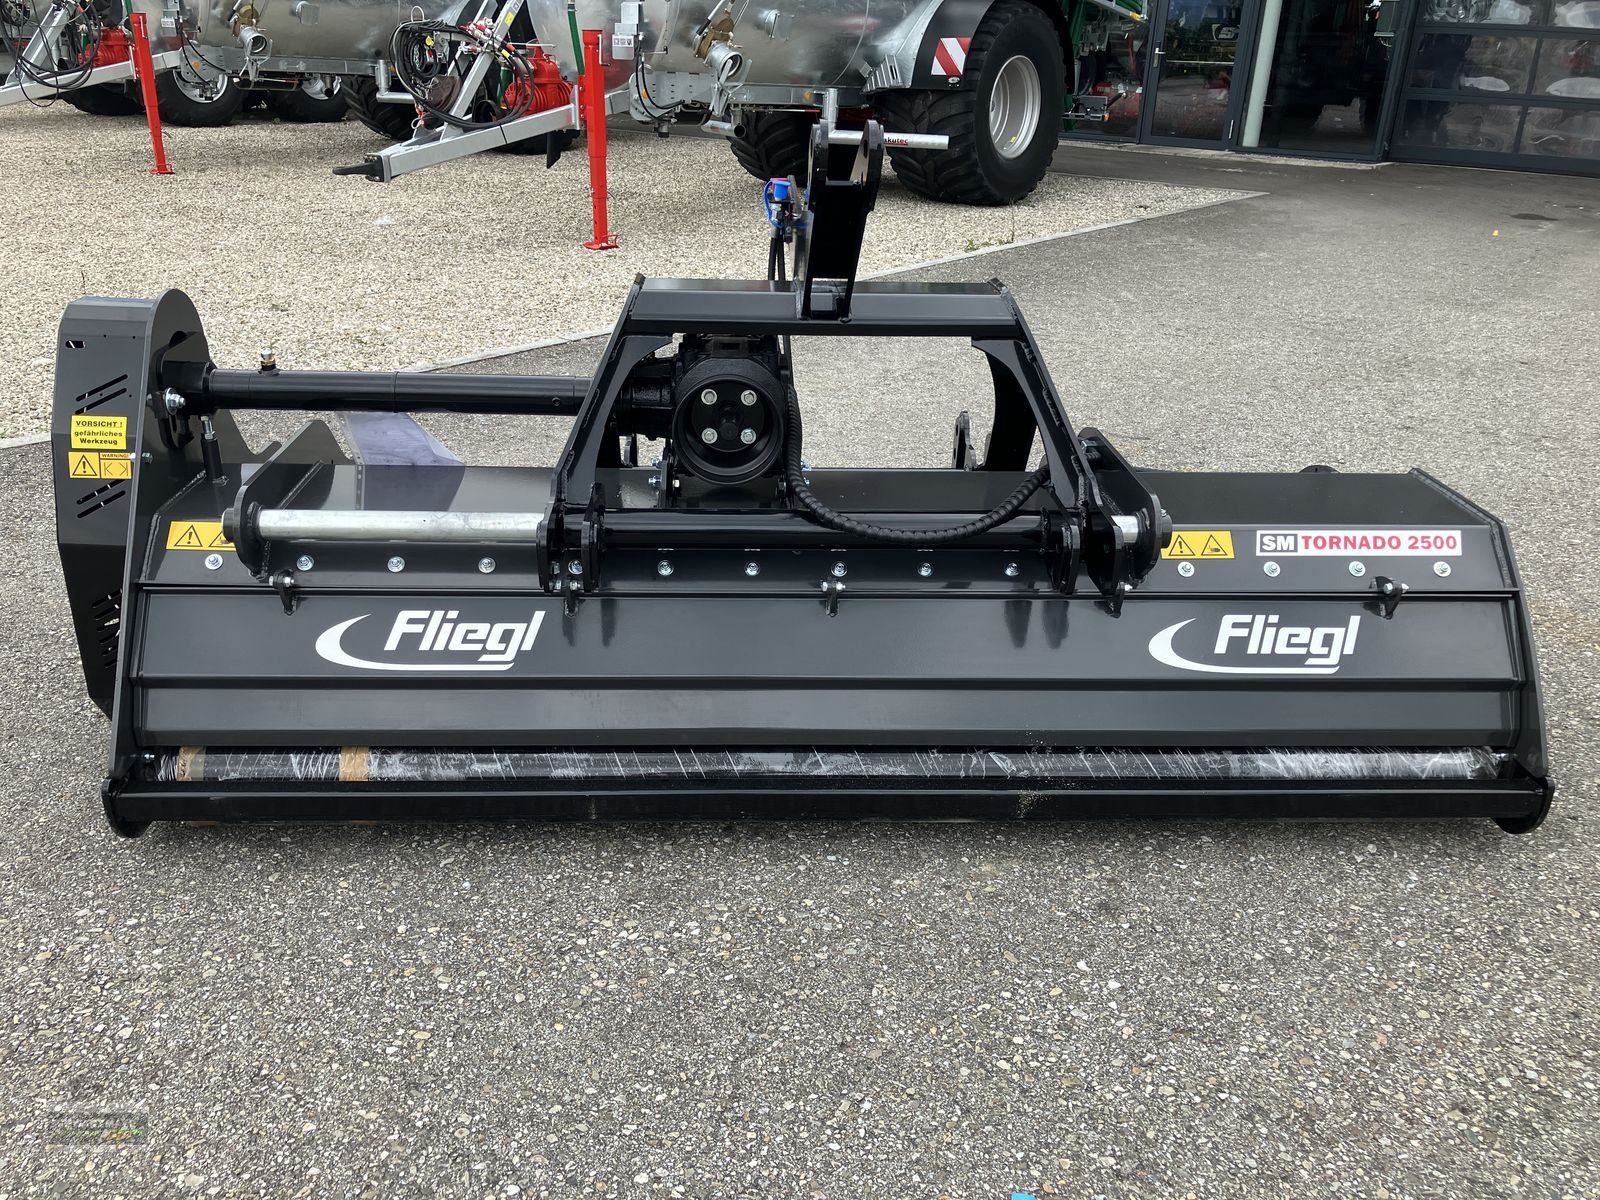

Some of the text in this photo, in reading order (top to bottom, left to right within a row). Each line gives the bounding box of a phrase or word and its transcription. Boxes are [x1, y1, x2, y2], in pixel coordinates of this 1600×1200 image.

[1262, 535, 1458, 551] SM TORNADO 2500
[383, 610, 546, 662] Fliegl
[1213, 614, 1361, 666] Fliegl
